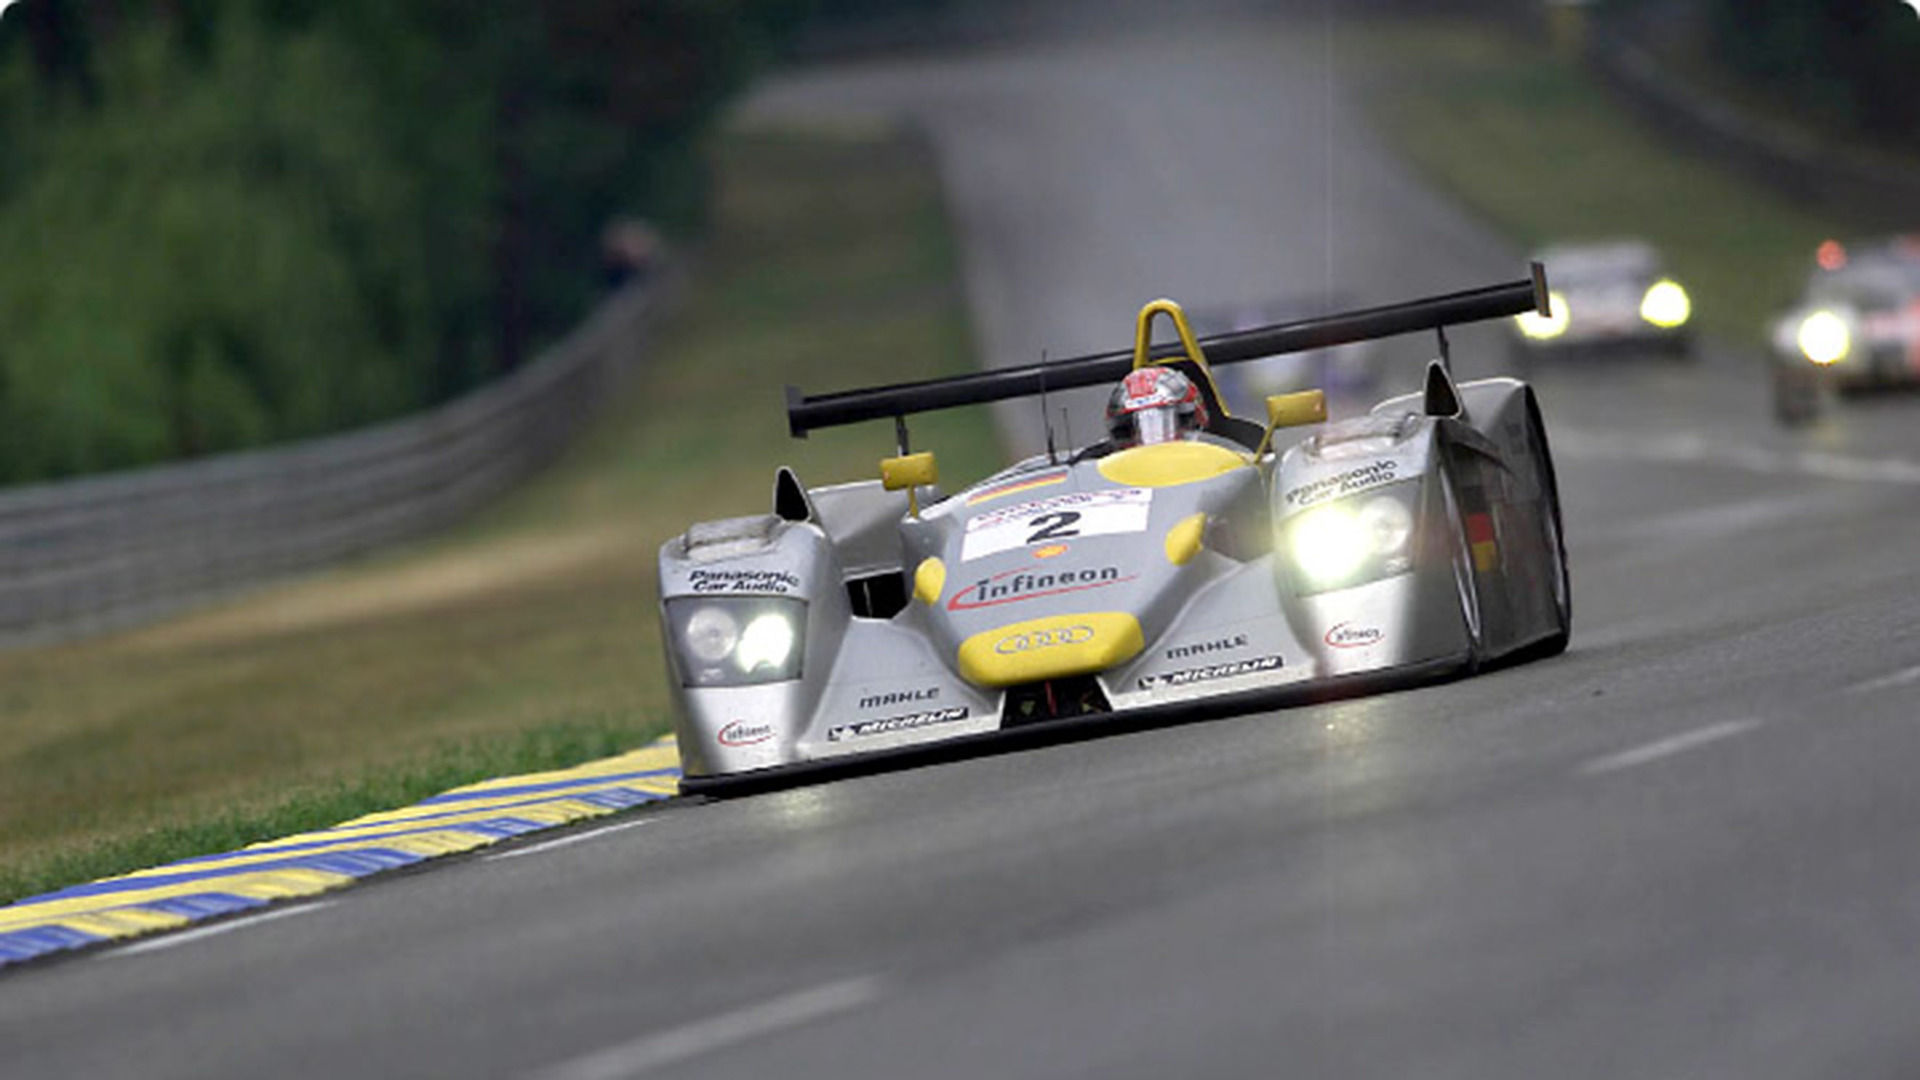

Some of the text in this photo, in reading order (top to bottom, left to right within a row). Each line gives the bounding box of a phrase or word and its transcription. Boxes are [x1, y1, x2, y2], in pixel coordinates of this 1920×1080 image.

[1286, 460, 1398, 503] Panasonic
[1340, 470, 1396, 493] Audio
[1027, 511, 1081, 544] 2
[689, 568, 799, 588] Panasonic
[693, 579, 788, 593] Car Audio
[1166, 634, 1249, 660] MAHLE
[1171, 656, 1279, 685] MICHELIN
[859, 687, 940, 709] MAHLE
[858, 708, 964, 735] MICHELIN
